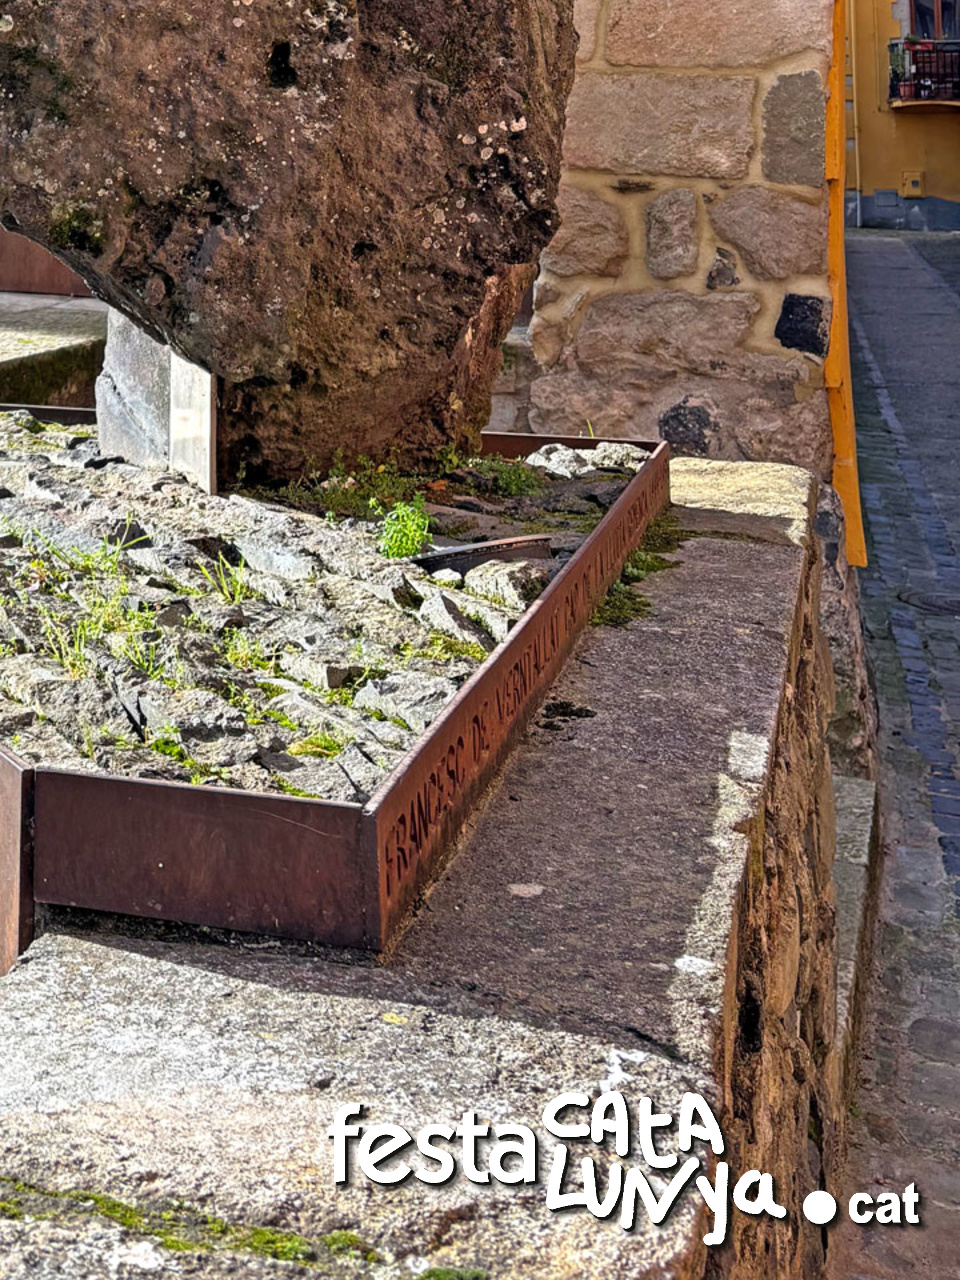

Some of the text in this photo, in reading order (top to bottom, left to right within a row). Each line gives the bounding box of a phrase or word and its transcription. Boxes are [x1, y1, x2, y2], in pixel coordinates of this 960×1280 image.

[386, 734, 467, 896] FRANCESC
[472, 701, 489, 761] DE
[496, 608, 560, 720] VERNTALLAT
